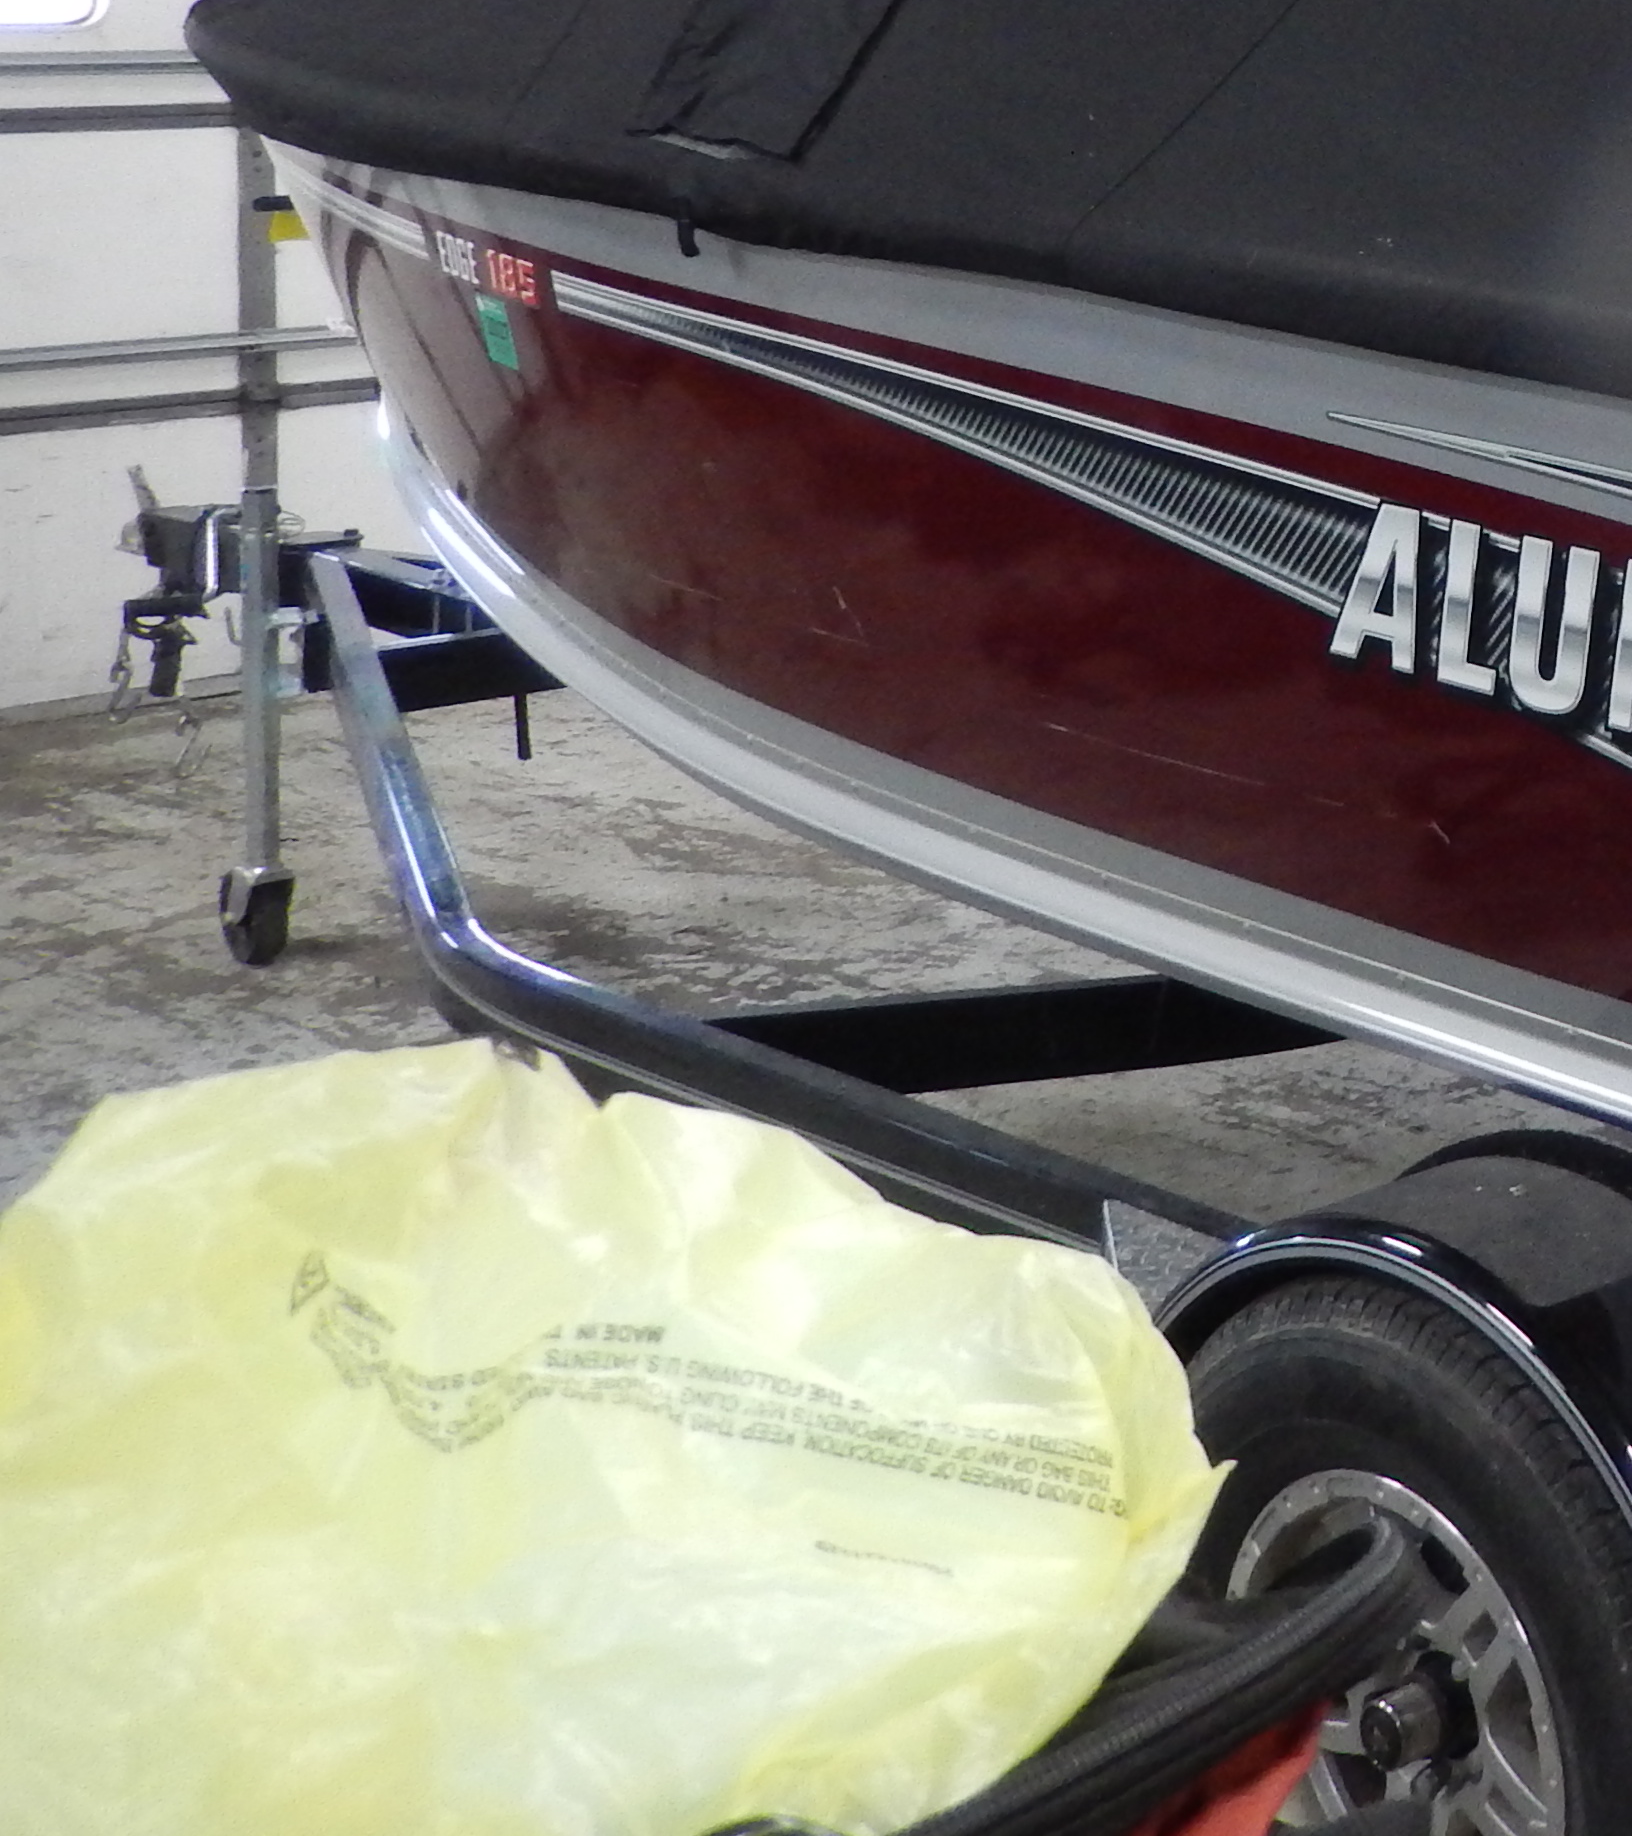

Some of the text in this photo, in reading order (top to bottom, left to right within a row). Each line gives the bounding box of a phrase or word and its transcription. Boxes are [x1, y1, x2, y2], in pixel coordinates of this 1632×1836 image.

[435, 230, 537, 306] EDGE 185
[575, 1325, 599, 1341] IN
[602, 1323, 664, 1344] MADE
[543, 1348, 640, 1371] PATENTS
[686, 1361, 804, 1398] FOLLOWING
[741, 1423, 796, 1445] KEEP
[791, 1406, 922, 1449] COMPONENTS
[952, 1445, 977, 1462] OF
[930, 1462, 956, 1480] OF
[1013, 1456, 1038, 1474] OR
[1041, 1461, 1075, 1483] BAG
[959, 1466, 1033, 1496] DANGER
[1078, 1470, 1110, 1494] THIS
[1036, 1482, 1084, 1506] AVOID
[1087, 1493, 1106, 1514] TO
